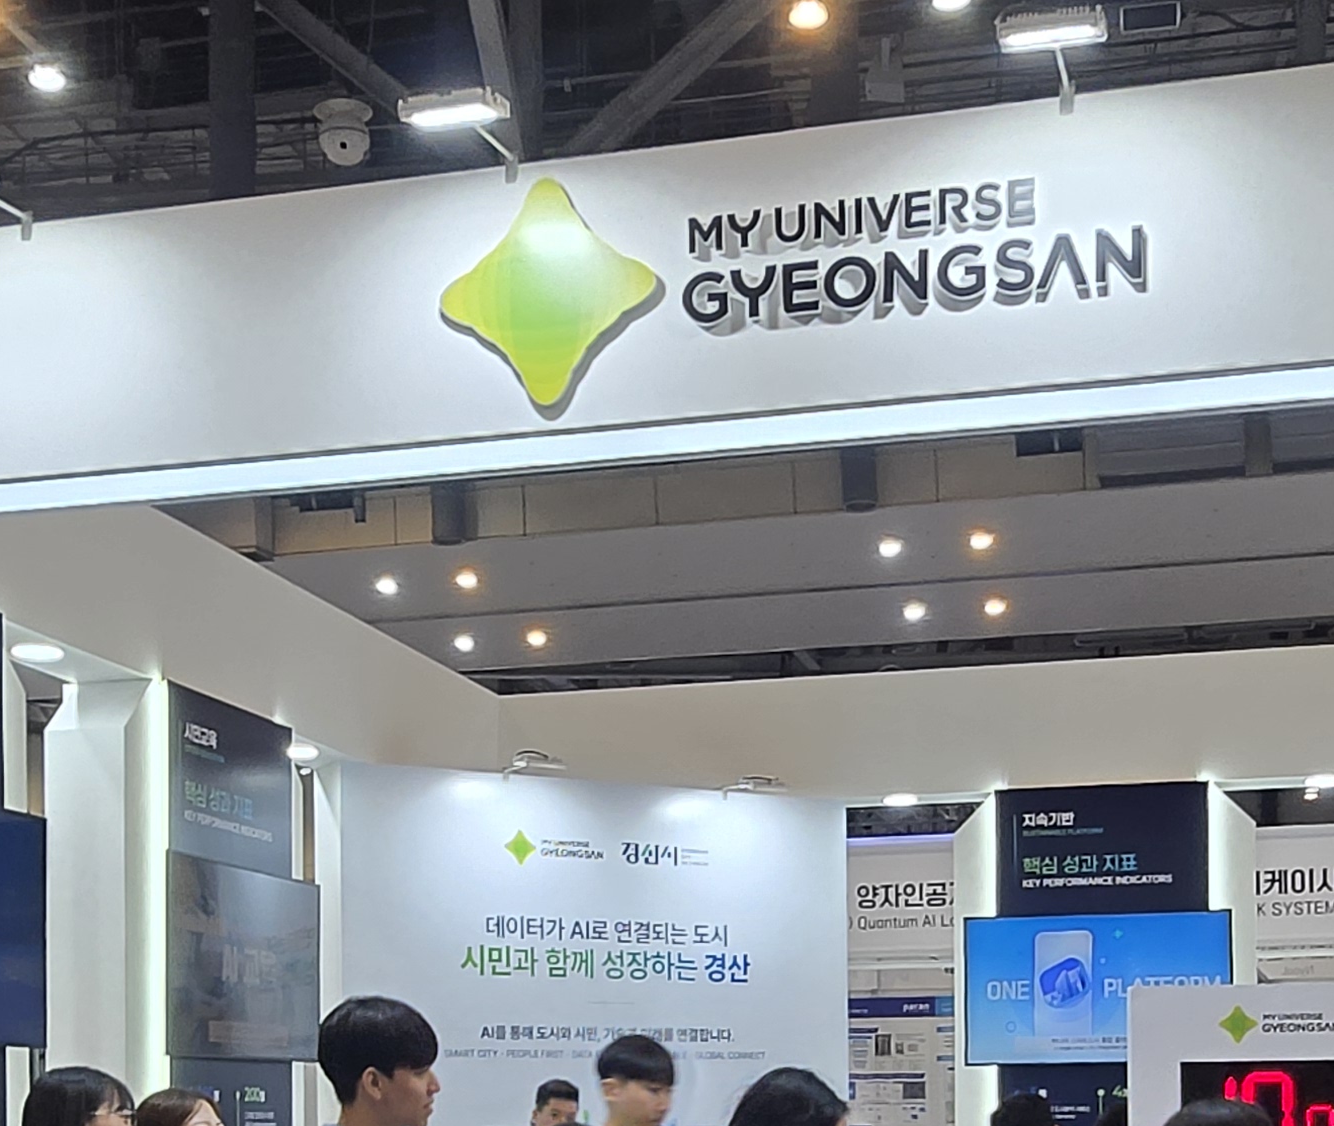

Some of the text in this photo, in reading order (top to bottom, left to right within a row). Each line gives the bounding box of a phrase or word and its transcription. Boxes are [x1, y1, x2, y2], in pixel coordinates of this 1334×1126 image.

[688, 177, 1036, 254] MY UNIVERSE
[682, 225, 1149, 324] GYEONGSAN
[540, 848, 605, 860] GYEONGSAN
[1022, 853, 1139, 875] 핵심 성과 지표
[1022, 873, 1173, 888] KEY PERFORMANCE INDICATORS
[485, 915, 729, 948] 데이터가 AI로 연결되는 도시
[857, 915, 919, 931] Quantum
[922, 914, 937, 928] AI
[460, 944, 751, 984] 시민과 함께 성장하는 경산
[986, 979, 1031, 1001] ONE
[477, 1049, 498, 1059] CITY
